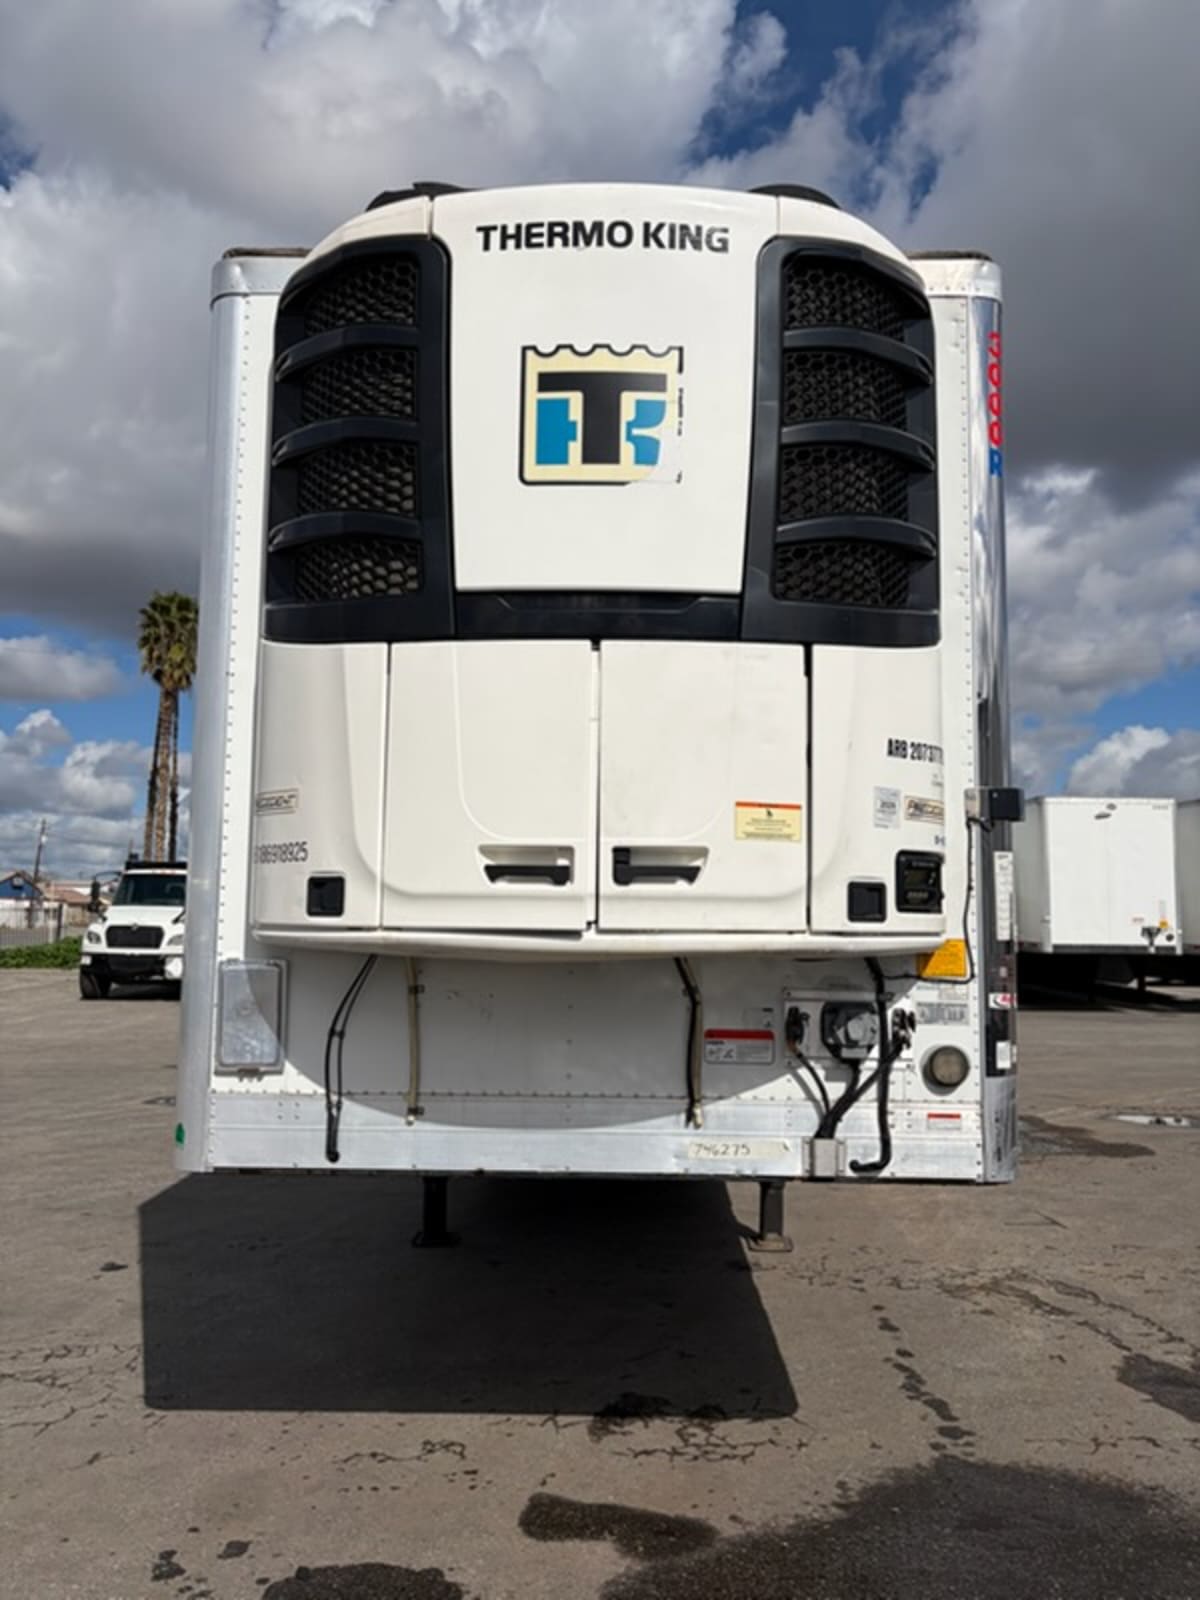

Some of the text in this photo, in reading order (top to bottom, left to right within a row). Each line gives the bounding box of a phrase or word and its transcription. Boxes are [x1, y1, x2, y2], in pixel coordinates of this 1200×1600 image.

[476, 221, 730, 253] THERMO KING
[887, 738, 908, 759] ARB
